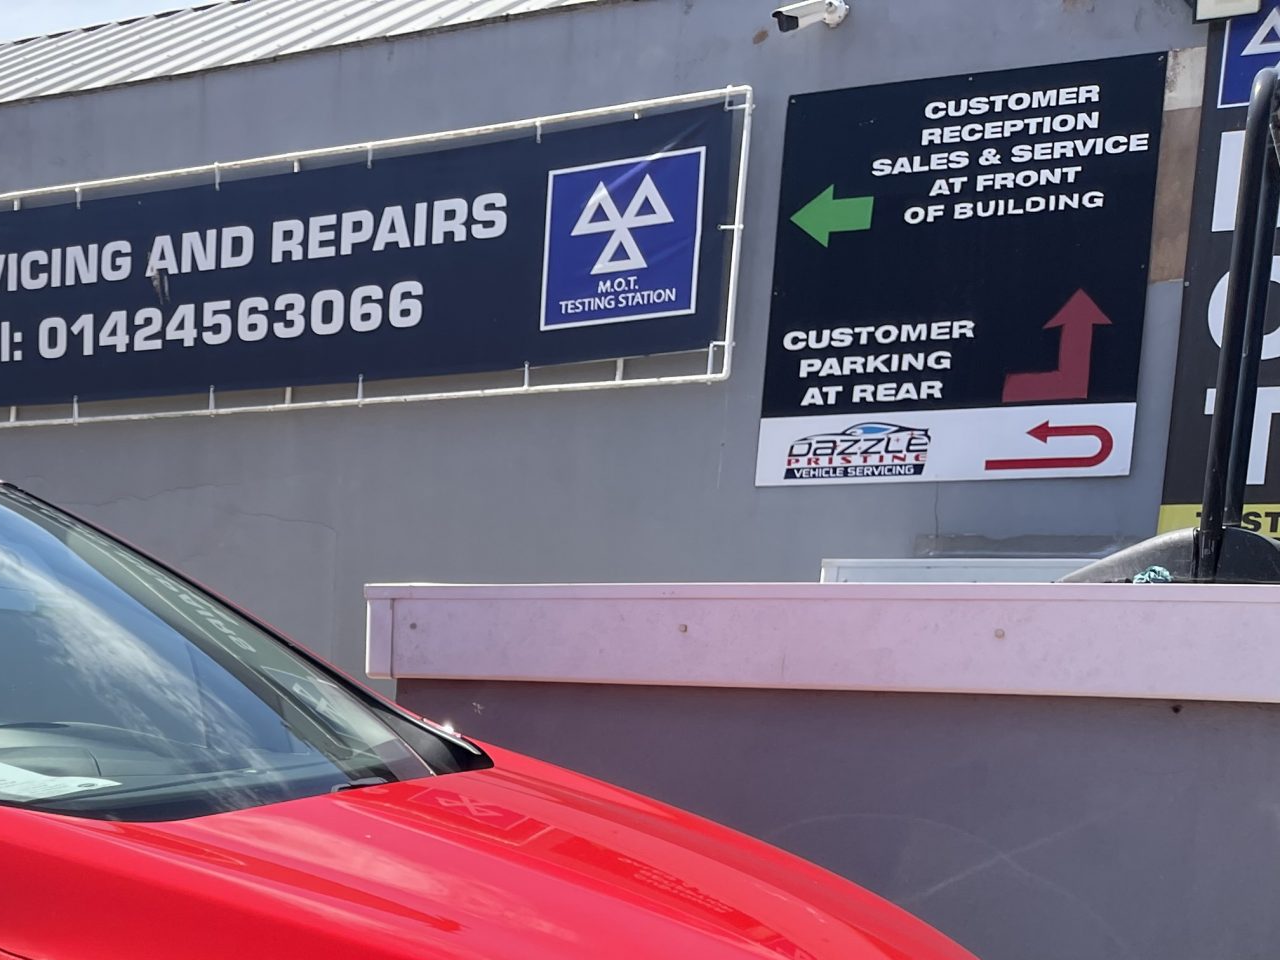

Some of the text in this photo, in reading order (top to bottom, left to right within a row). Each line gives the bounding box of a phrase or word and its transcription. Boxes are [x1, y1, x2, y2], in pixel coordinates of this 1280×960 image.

[924, 84, 1101, 119] CUSTOMER
[921, 111, 1100, 146] RECEPTION
[871, 133, 1150, 177] SALES & SERVICE
[929, 166, 1082, 197] AT FRONT
[904, 190, 1105, 225] OF BUILDING
[145, 224, 255, 279] AND
[271, 192, 508, 264] REPAIRS
[597, 275, 639, 293] M.O.T.
[559, 287, 677, 315] TESTING STATION
[38, 280, 424, 360] 01424563066
[782, 320, 976, 351] CUSTOMER
[799, 351, 952, 378] PARKING
[800, 380, 943, 406] AT REAR
[786, 453, 928, 467] PRISTINE
[793, 464, 915, 478] VEHICLE SERVICING
